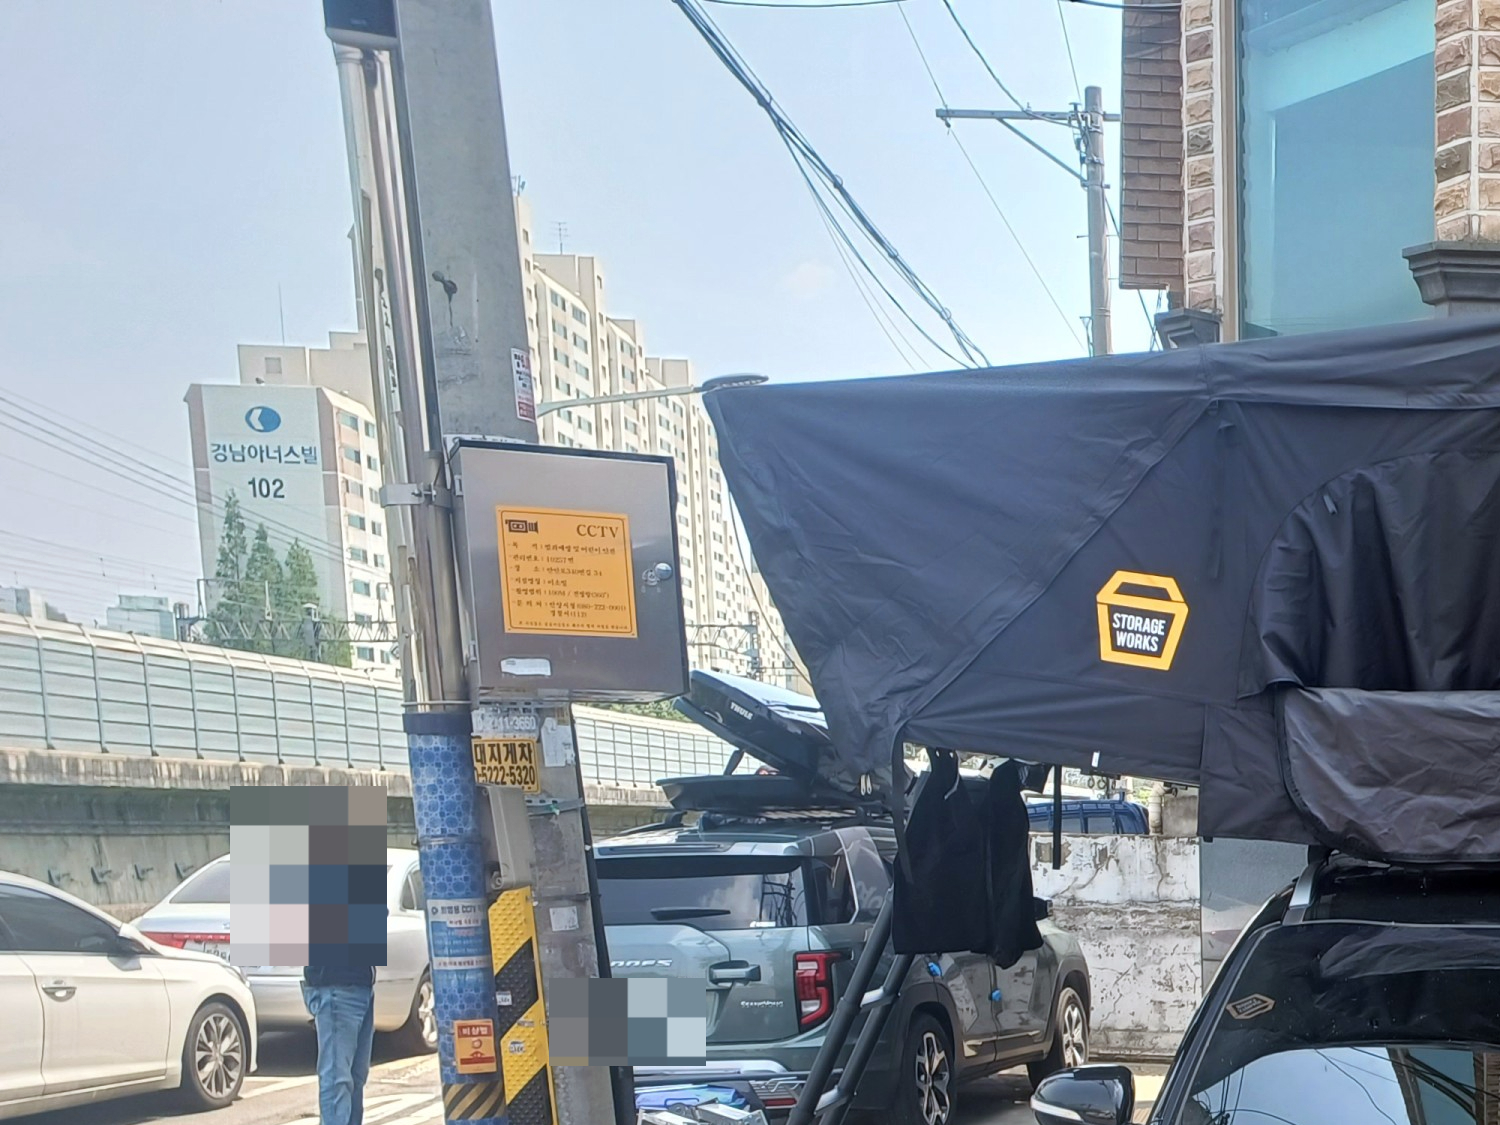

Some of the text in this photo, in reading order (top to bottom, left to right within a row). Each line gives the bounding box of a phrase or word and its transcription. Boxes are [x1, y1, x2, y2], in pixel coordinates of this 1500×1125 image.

[210, 443, 318, 465] 경남아너스빌
[247, 476, 285, 499] 102
[576, 524, 619, 538] CCTV
[1112, 612, 1166, 636] STORAGE
[1116, 630, 1159, 652] WORKS
